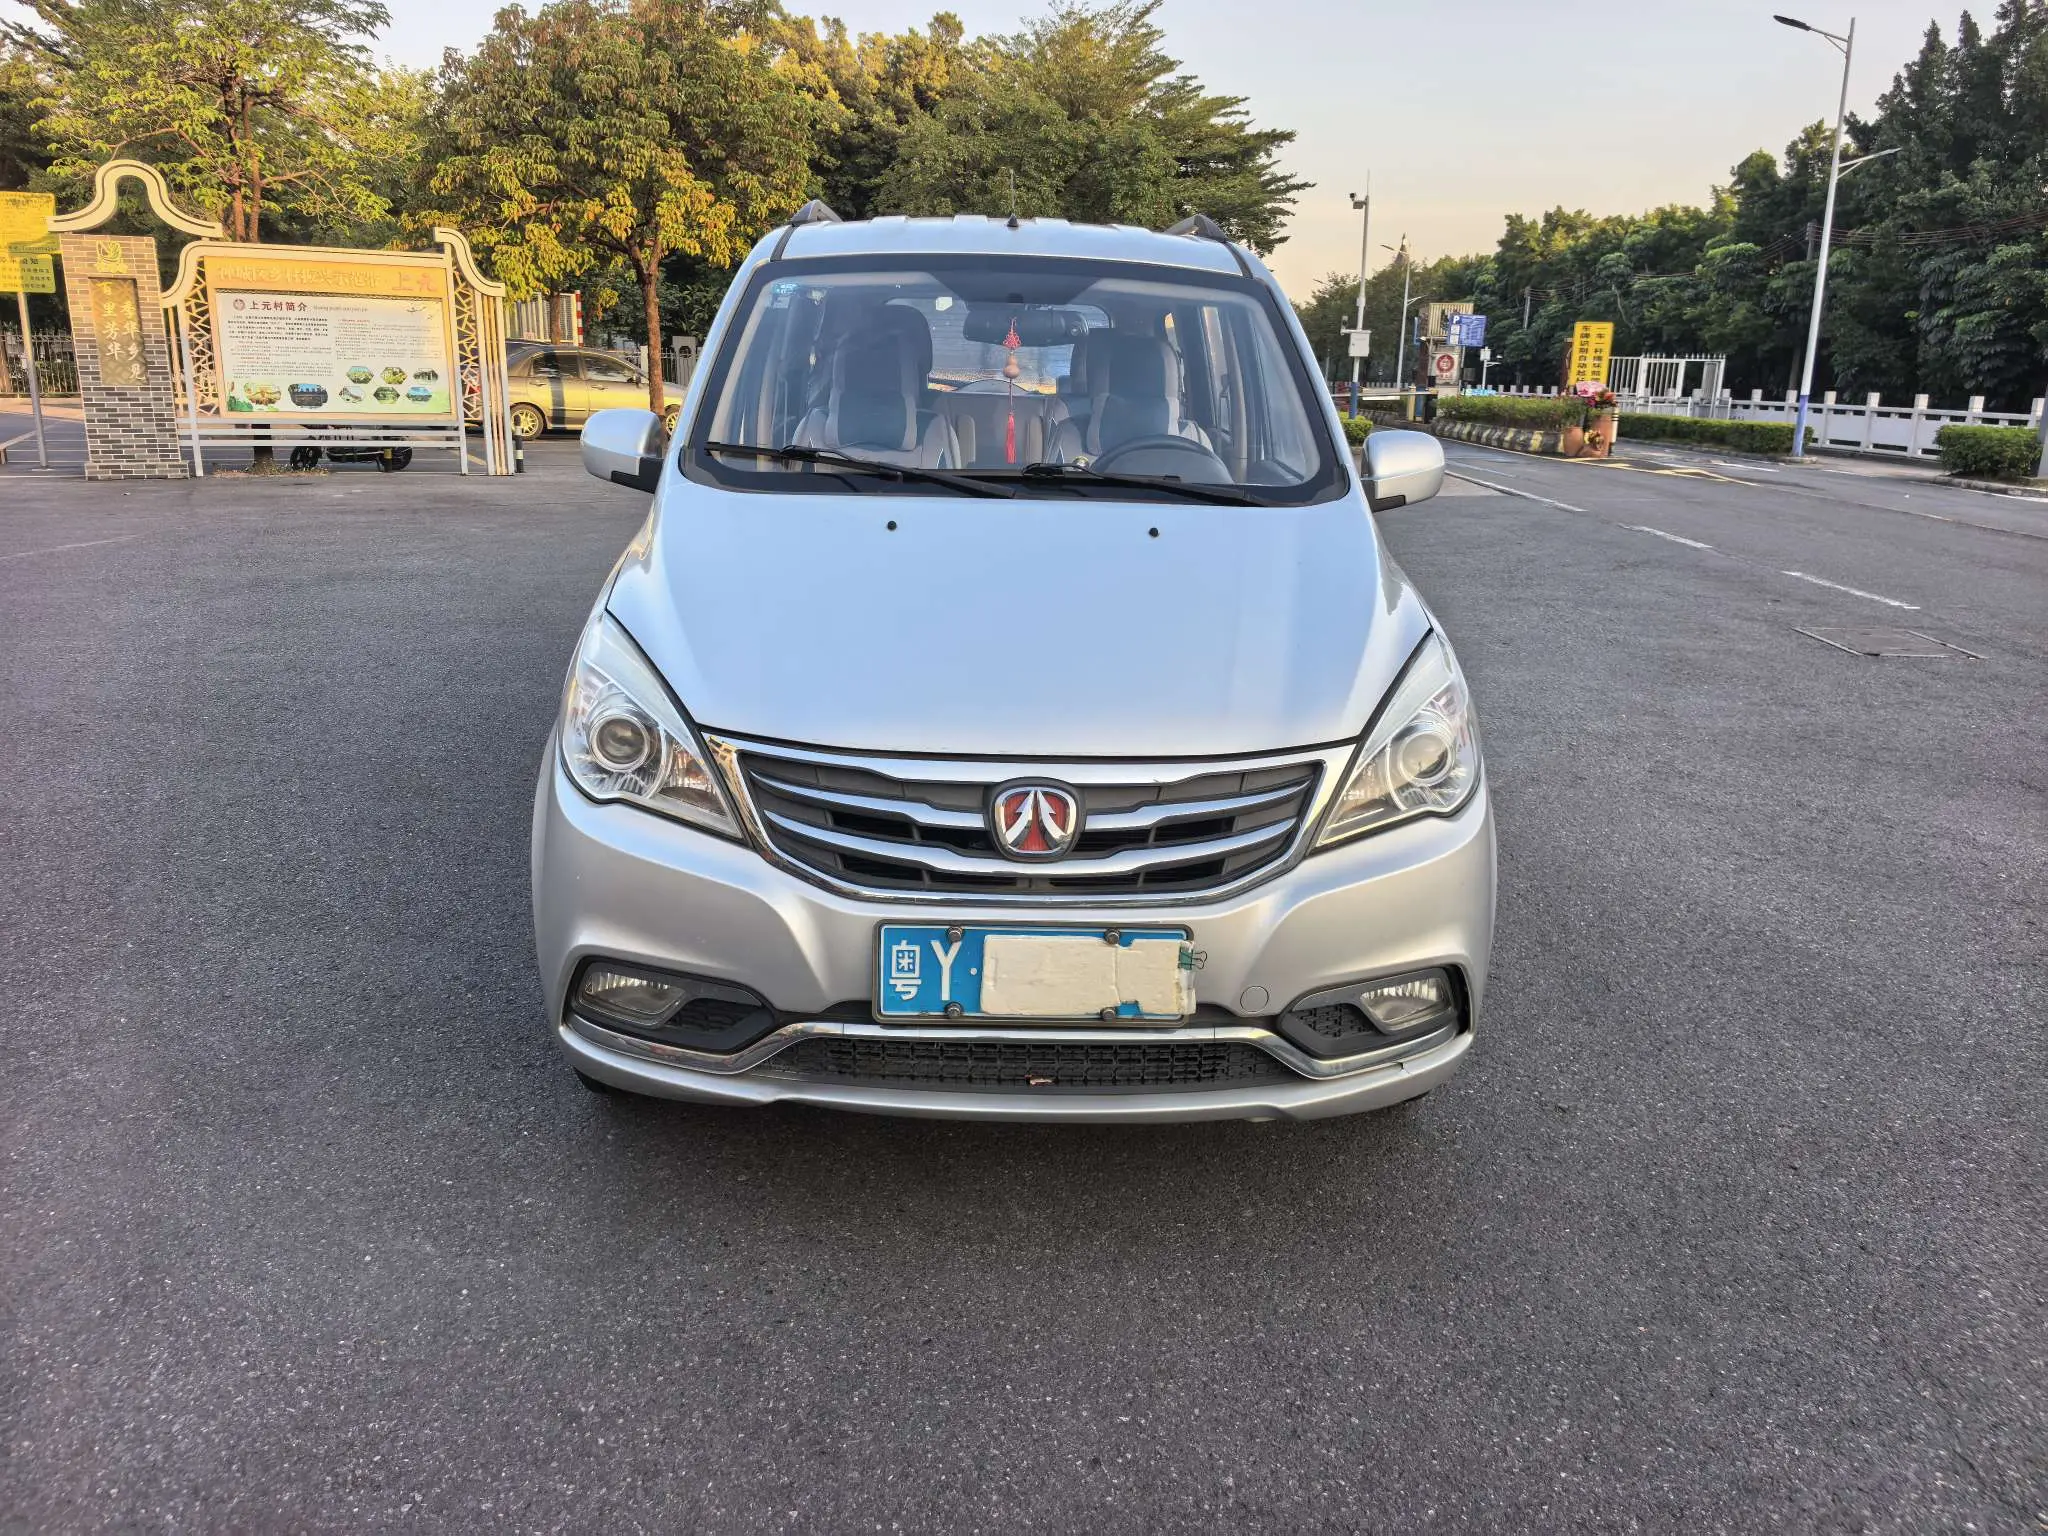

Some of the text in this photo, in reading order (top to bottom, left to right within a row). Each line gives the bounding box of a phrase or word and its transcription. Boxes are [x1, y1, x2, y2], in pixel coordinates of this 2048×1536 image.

[249, 300, 309, 312] 上元村简介
[1453, 315, 1460, 325] P
